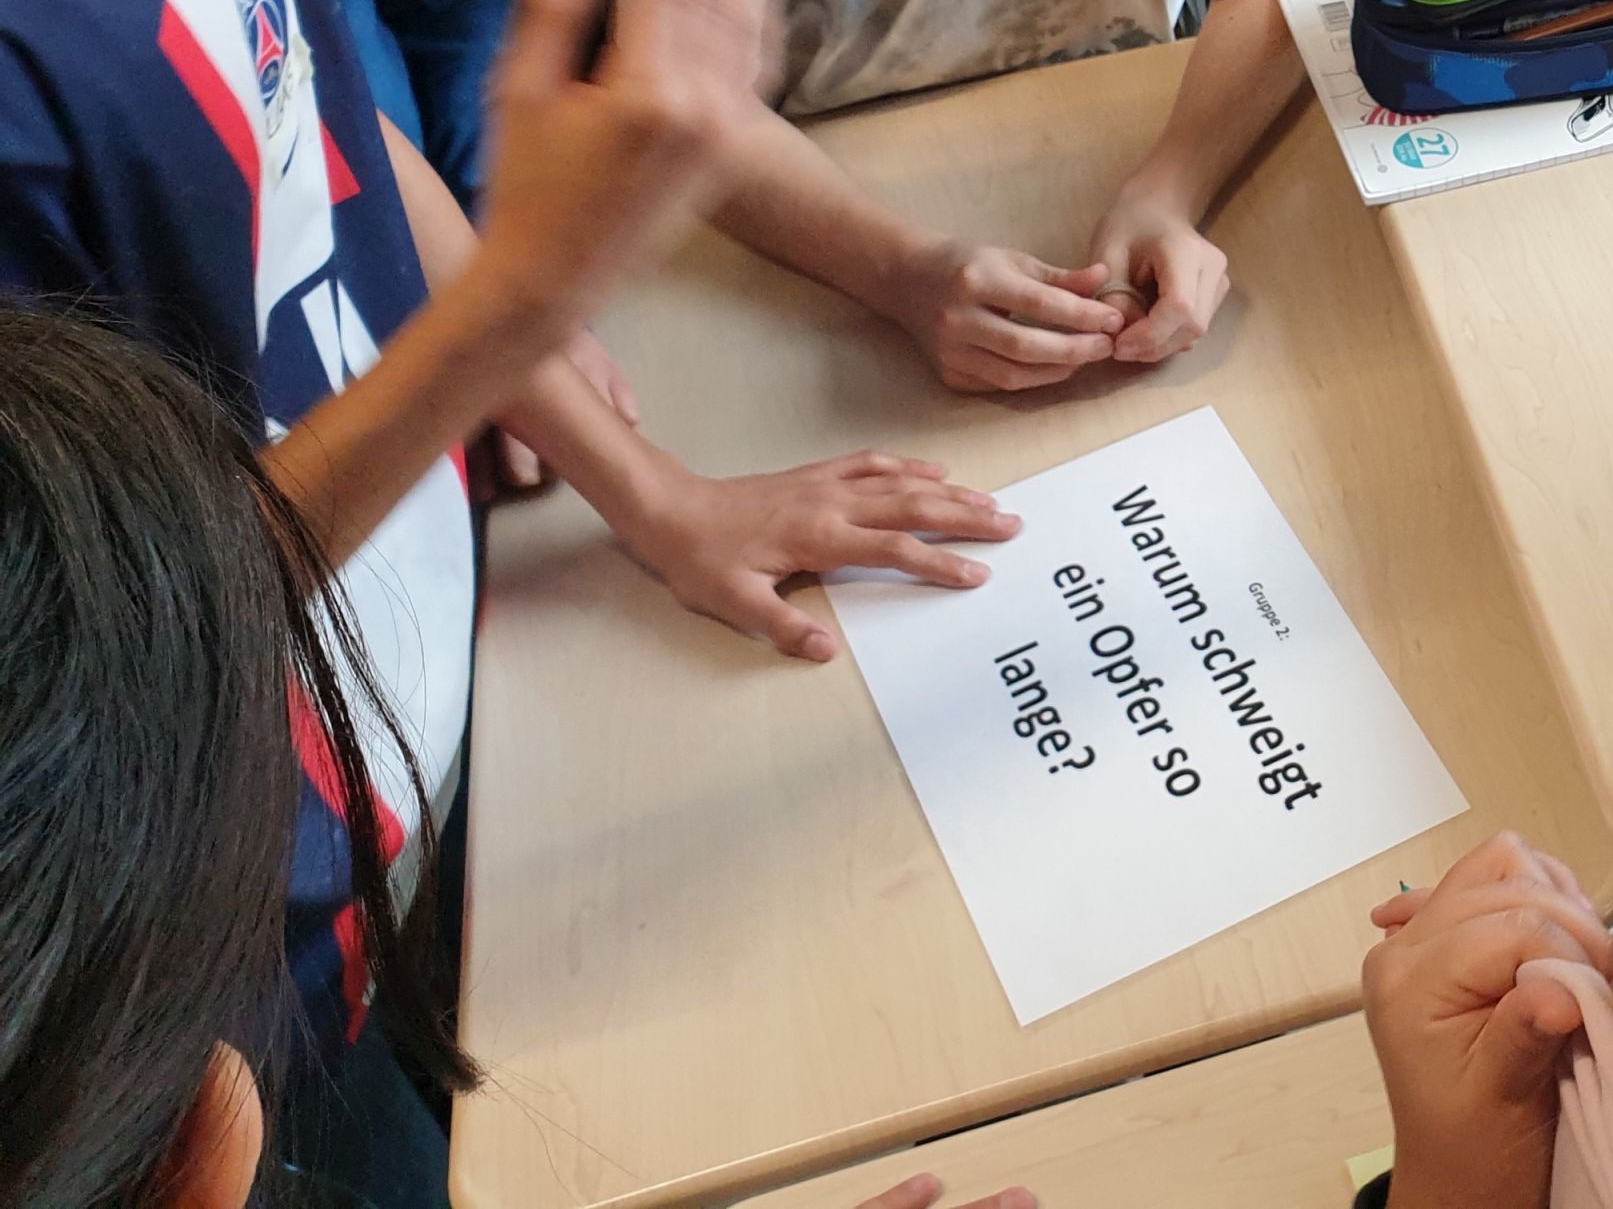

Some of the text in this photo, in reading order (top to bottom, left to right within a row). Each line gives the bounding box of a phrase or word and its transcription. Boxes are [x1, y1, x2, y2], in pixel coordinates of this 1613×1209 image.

[1416, 133, 1451, 156] 27
[1111, 484, 1323, 812] Warum schweigt
[1248, 581, 1290, 642] Gruppe 2:
[993, 640, 1097, 775] lange?
[1052, 563, 1202, 798] ein Opfer so
